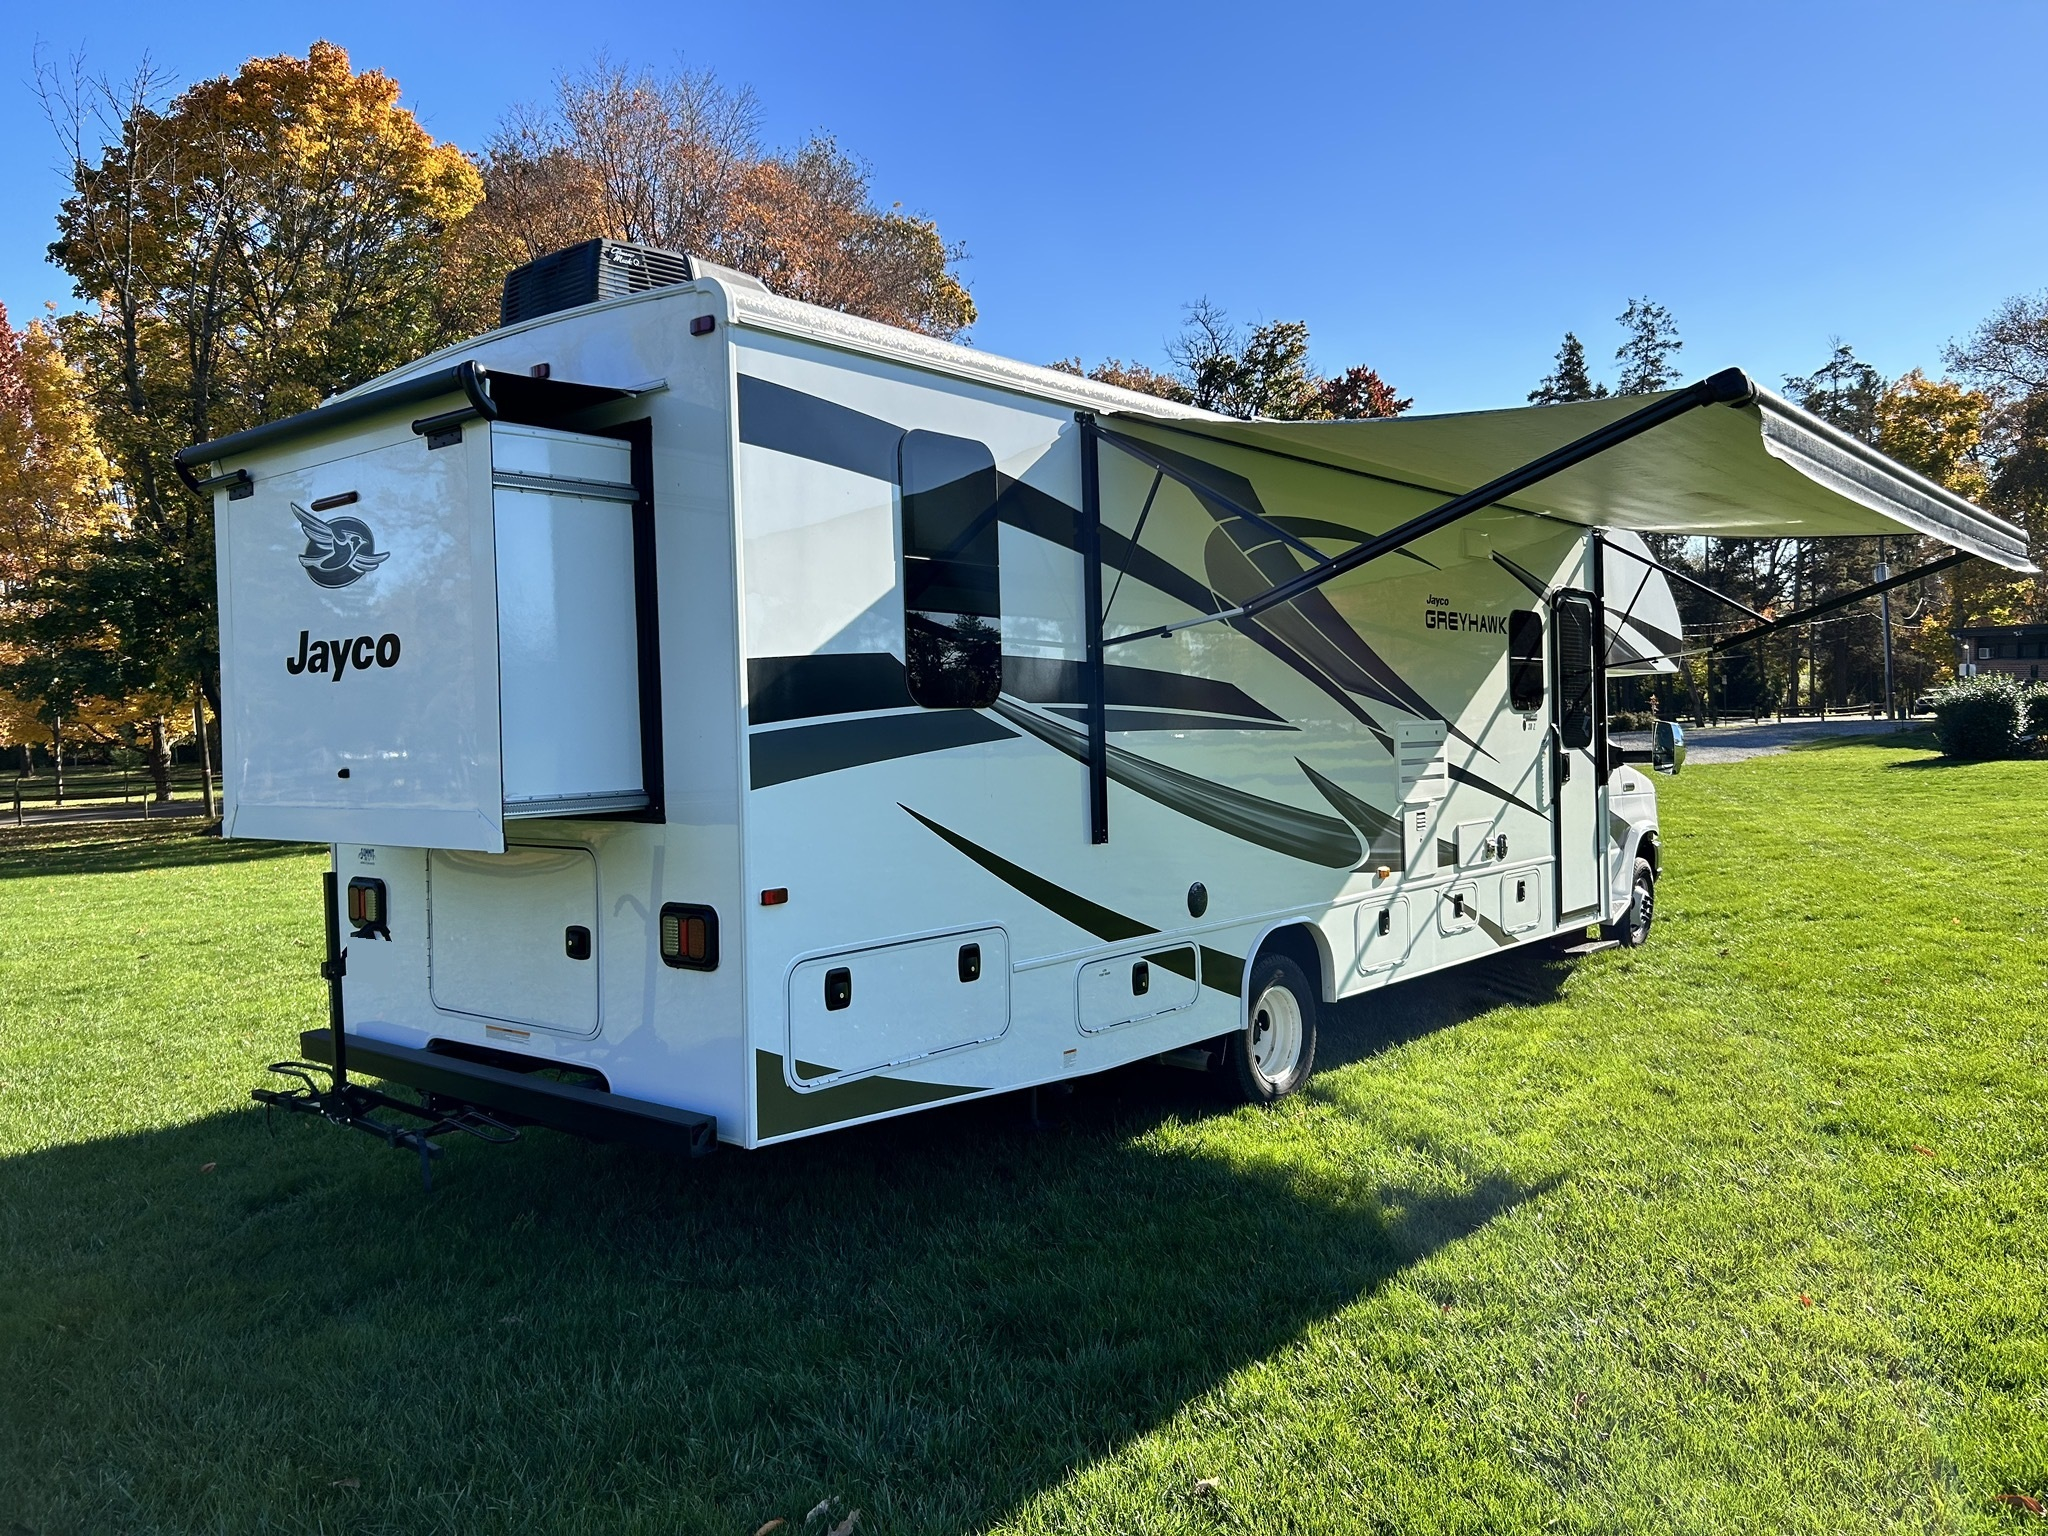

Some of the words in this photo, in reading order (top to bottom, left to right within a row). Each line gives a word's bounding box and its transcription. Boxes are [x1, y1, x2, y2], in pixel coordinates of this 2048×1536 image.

[1426, 594, 1450, 607] Jayco
[1425, 609, 1507, 635] GREYHAWK
[286, 630, 402, 682] Jayco
